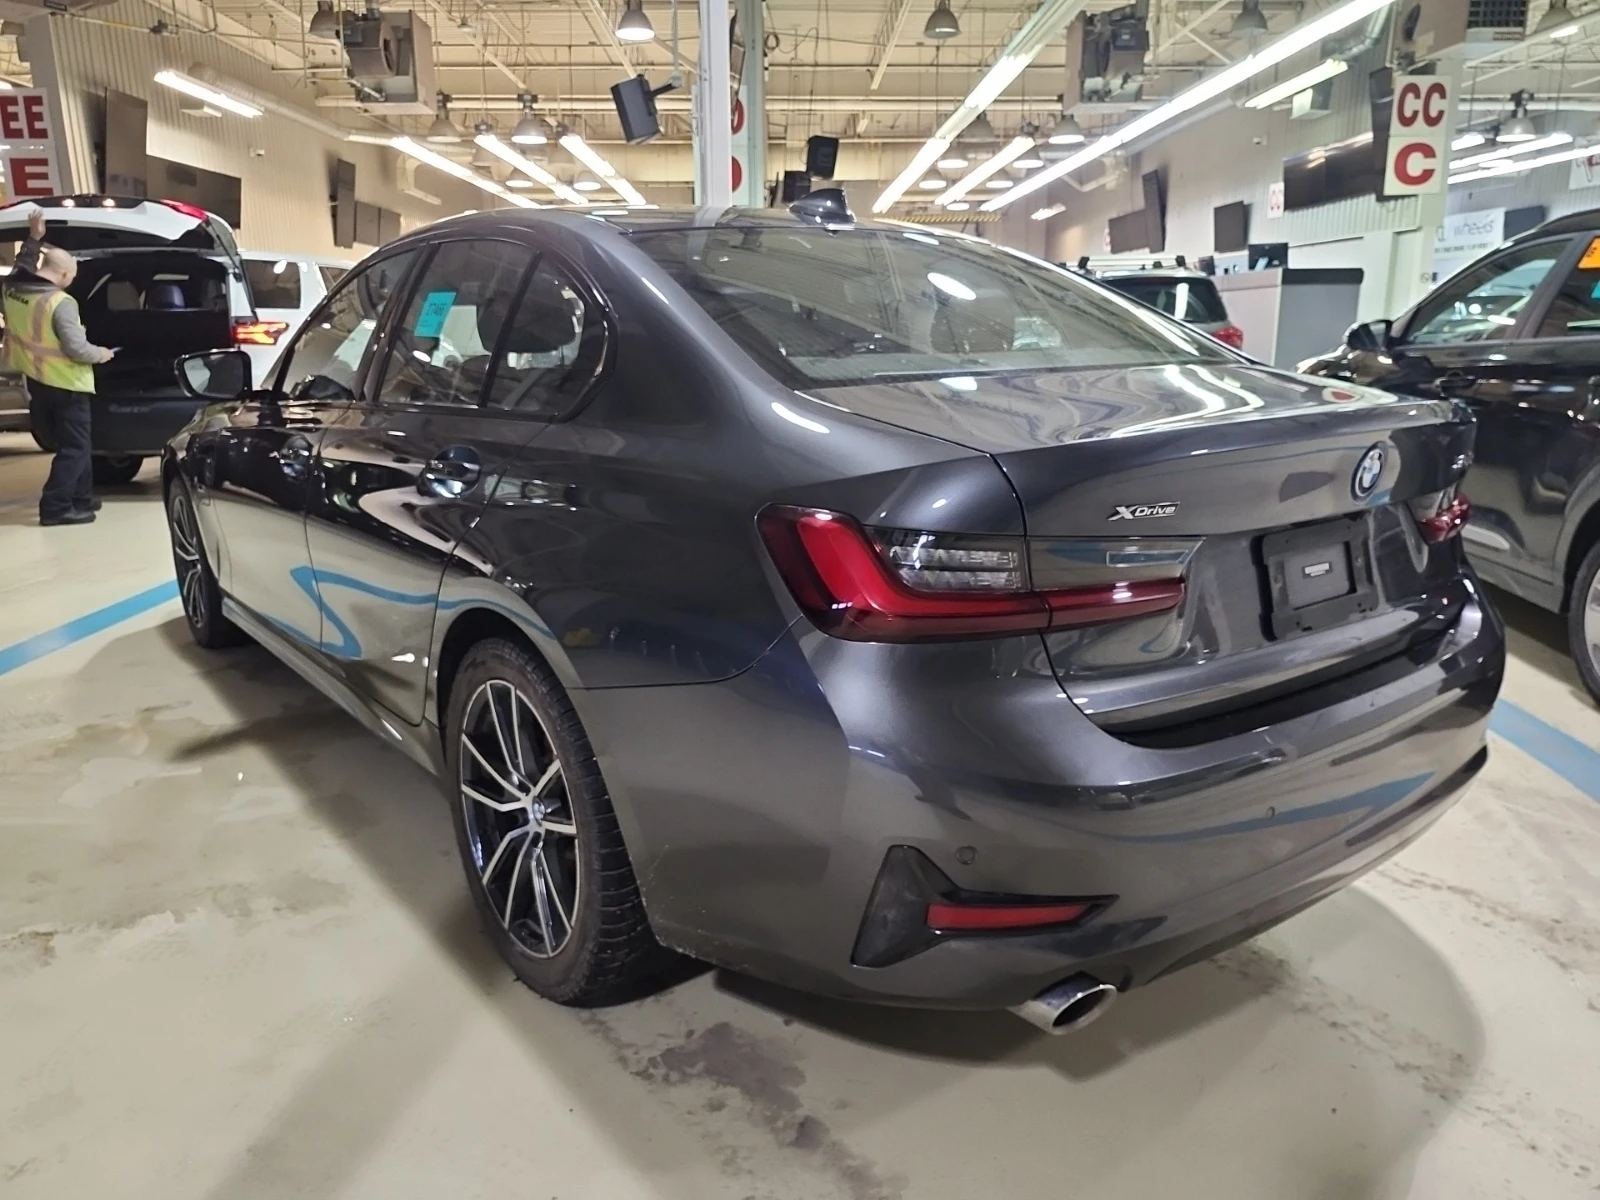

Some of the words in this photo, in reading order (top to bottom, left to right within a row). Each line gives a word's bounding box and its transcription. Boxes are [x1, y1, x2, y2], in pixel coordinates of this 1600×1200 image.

[0, 95, 49, 139] EE
[1397, 82, 1447, 128] CC
[9, 158, 54, 196] E
[1394, 142, 1436, 186] C
